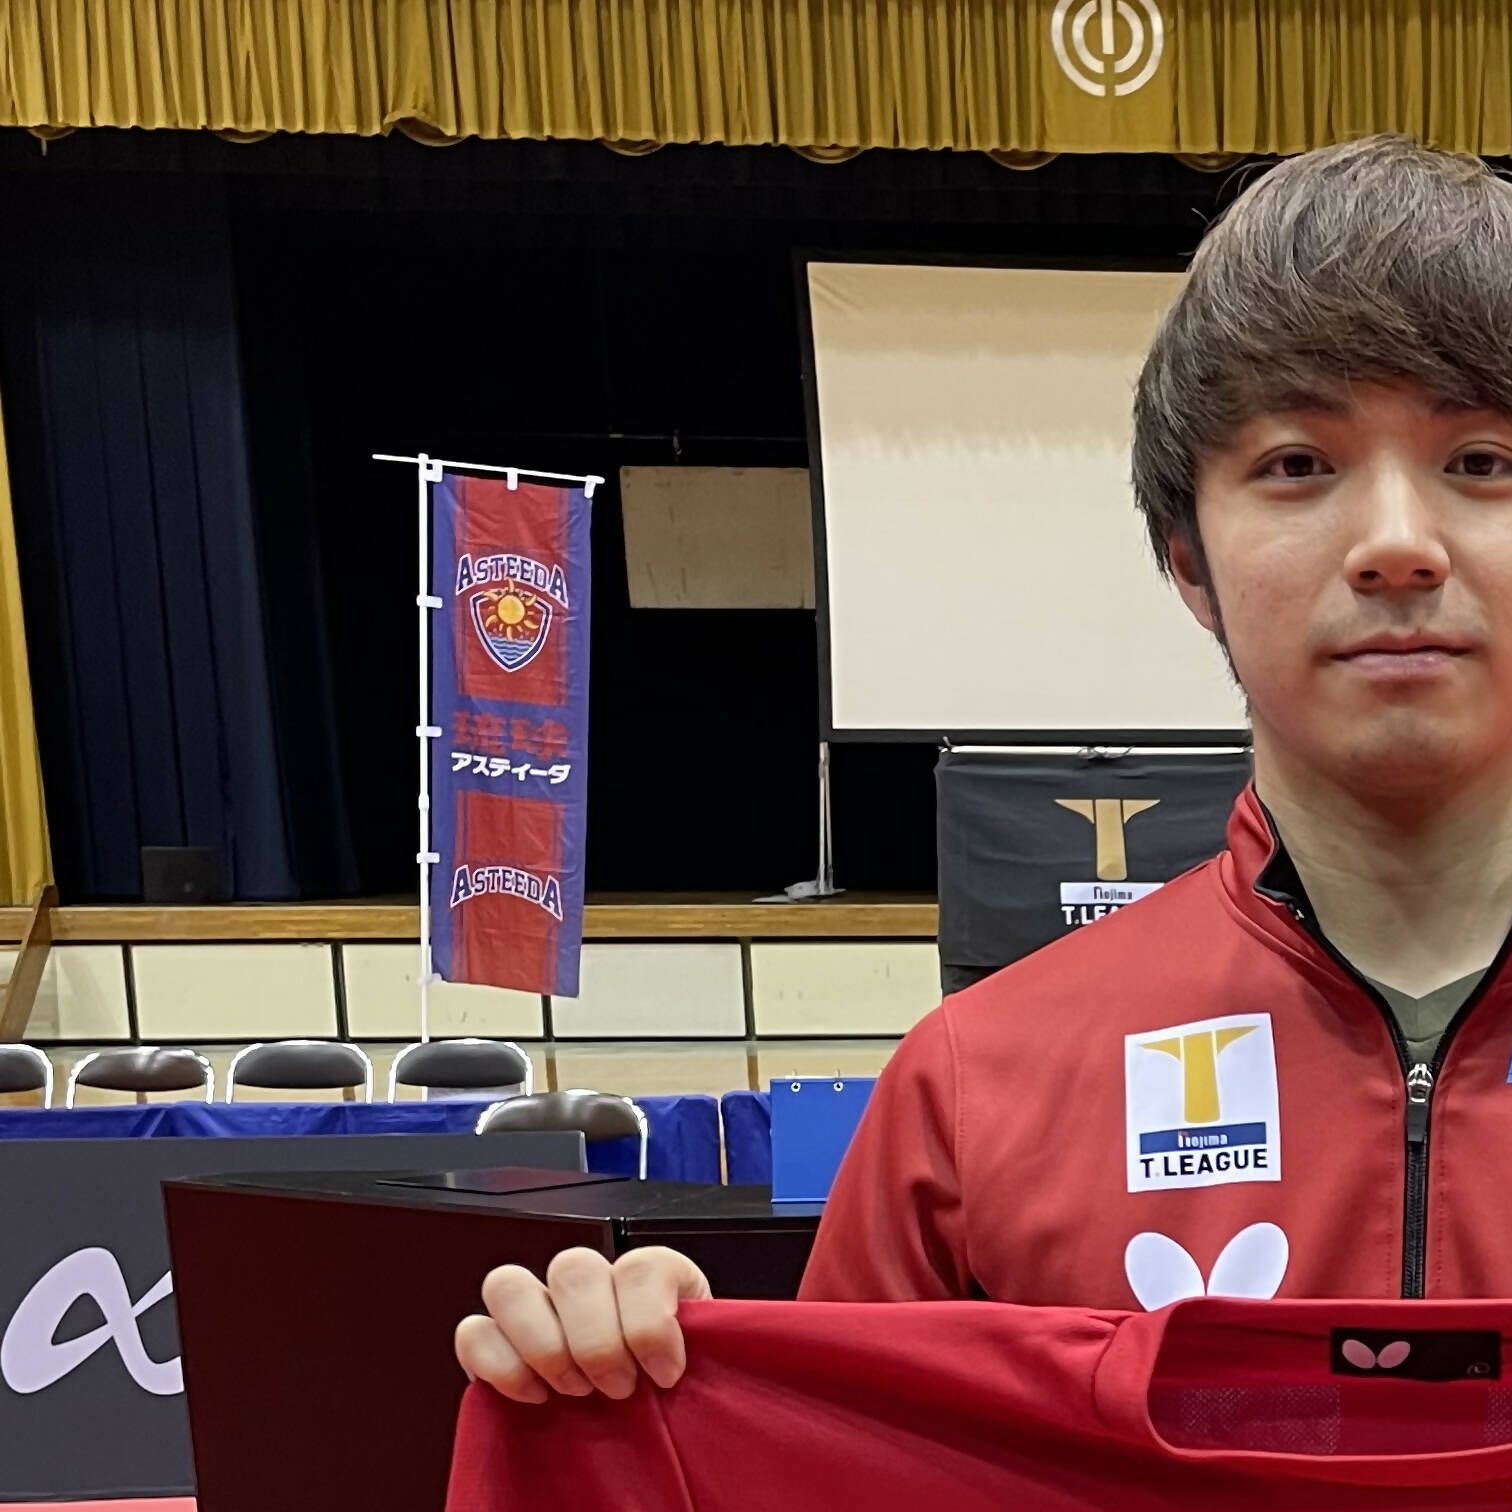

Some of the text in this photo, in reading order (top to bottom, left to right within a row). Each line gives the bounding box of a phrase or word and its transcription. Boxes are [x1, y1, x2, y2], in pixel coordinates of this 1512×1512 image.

[456, 553, 569, 609] ASTEEDA
[451, 752, 572, 784] アスティータ
[450, 864, 563, 922] ASTEEDA
